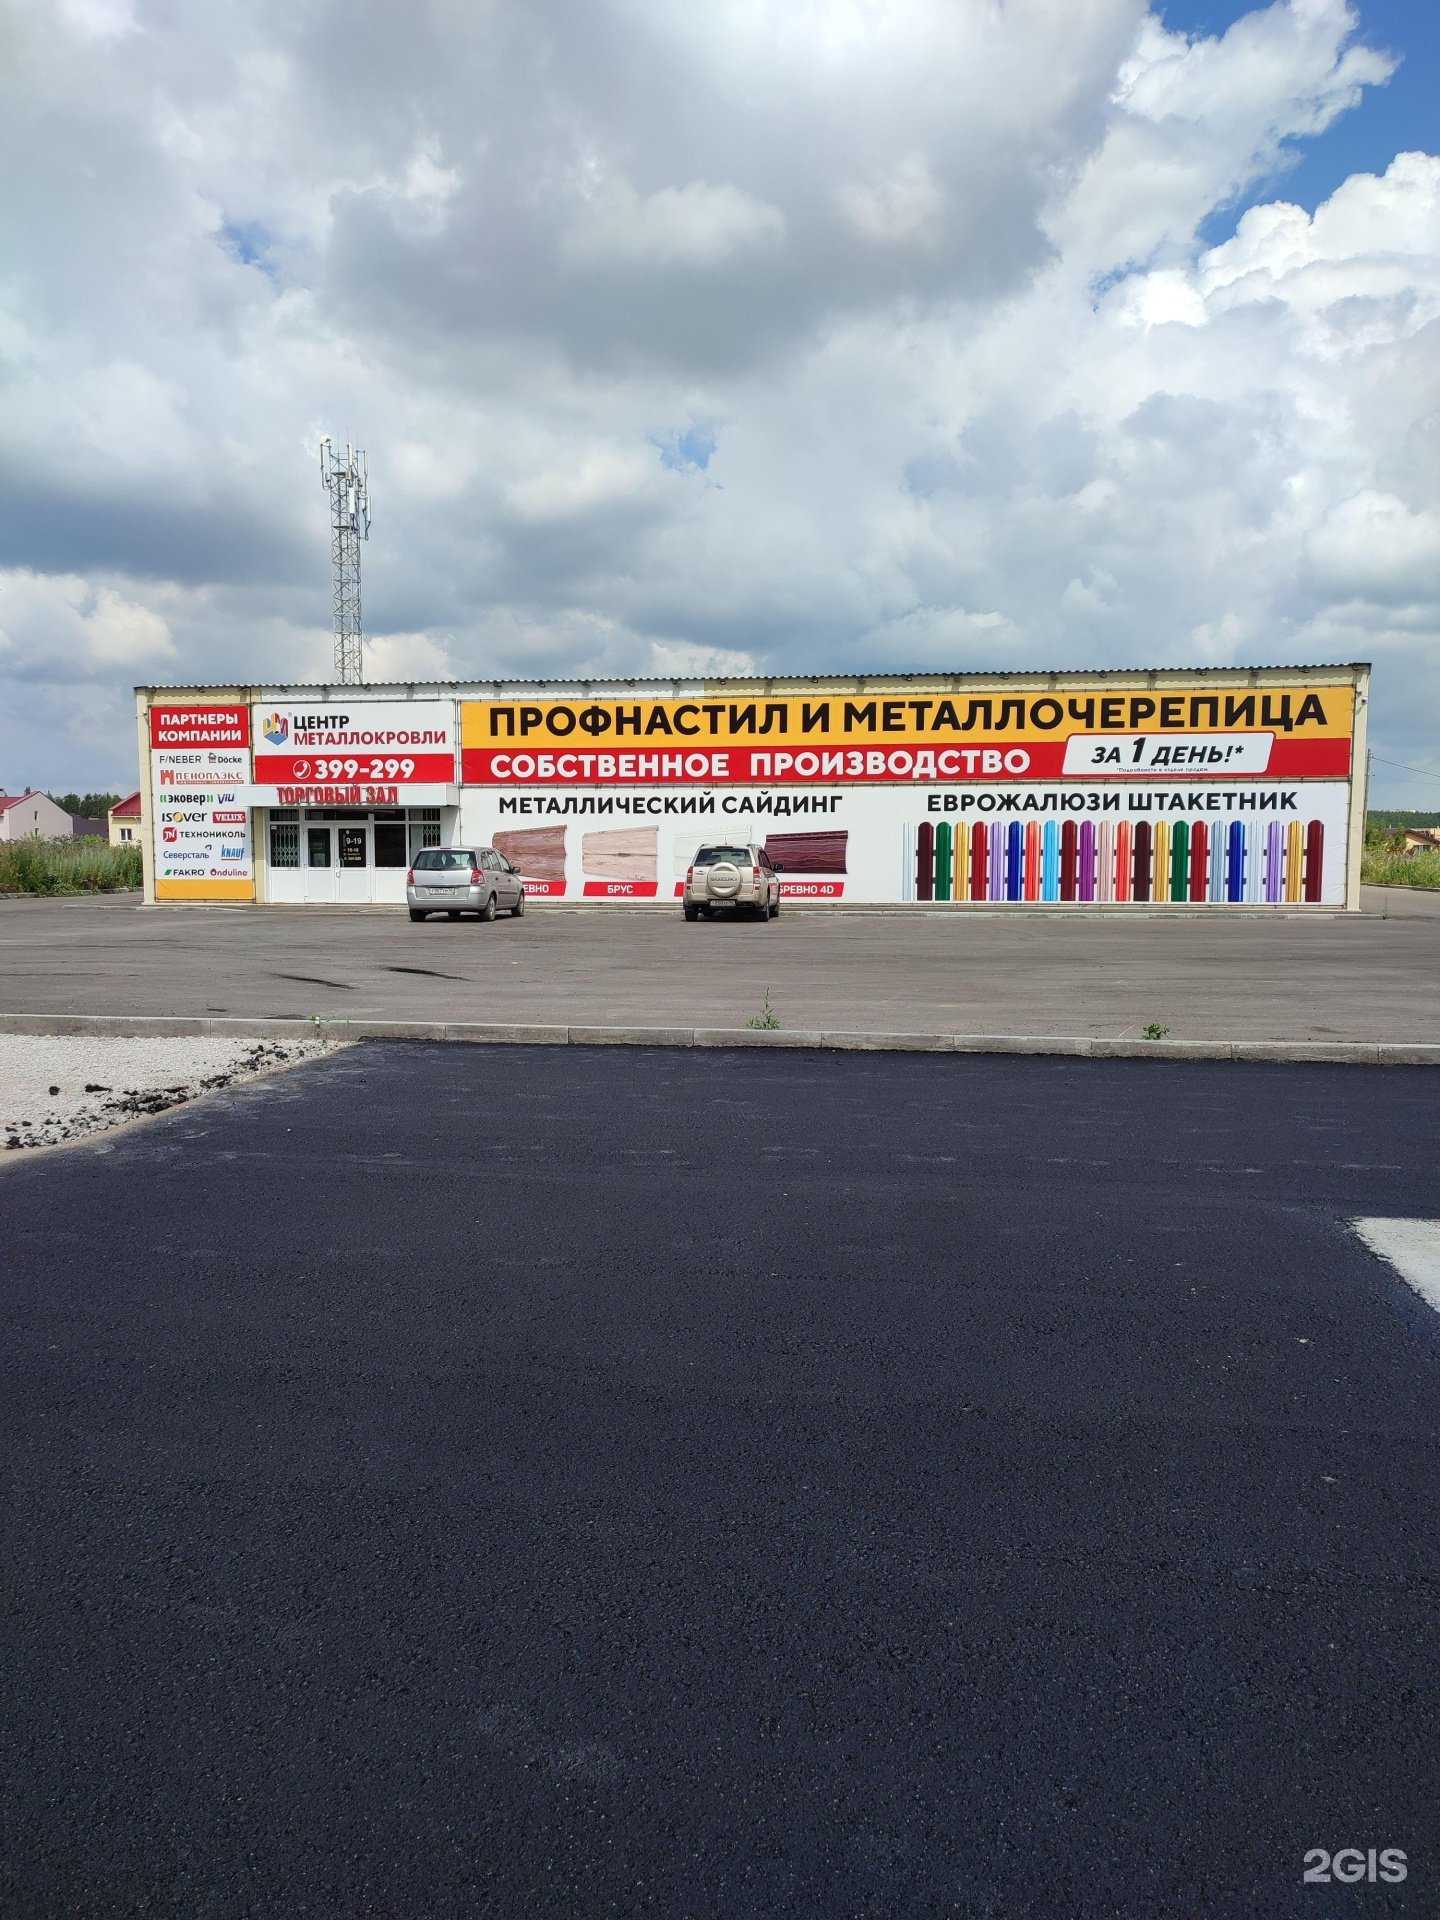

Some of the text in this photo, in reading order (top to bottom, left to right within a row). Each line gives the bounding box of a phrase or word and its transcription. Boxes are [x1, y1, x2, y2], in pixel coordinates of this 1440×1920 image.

[160, 713, 238, 725] ПАРТНЕРЫ
[293, 715, 350, 731] ЦЕНТР
[490, 694, 1328, 737] ПРОФНАСТИЛ И МЕТАЛЛОЧЕРЕПИЦА
[158, 730, 242, 742] КОМПАНИИ
[294, 731, 447, 746] МЕТАЛЛОКРОВЛИ
[1091, 746, 1122, 764] ЗА
[1132, 736, 1147, 763] 1
[314, 759, 416, 779] 399-299
[490, 749, 1031, 779] СОБСТВЕННОЕ ПРОИЗВОДСТВО
[277, 784, 399, 805] ТОРГОВЫЙ ЗАЛ
[928, 791, 1298, 812] ЕВРОЖАЛЮЗИ ШТАКЕТНИК
[499, 790, 843, 816] МЕТАЛЛИЧЕСКИЙ САЙДИНГ
[180, 831, 246, 839] ТЕХНОНИКОЛЬ
[163, 850, 210, 861] Северсталь
[173, 868, 205, 877] FAKRO
[524, 884, 550, 894] ЕВНО
[607, 884, 634, 894] БРУС
[820, 885, 834, 895] 4D
